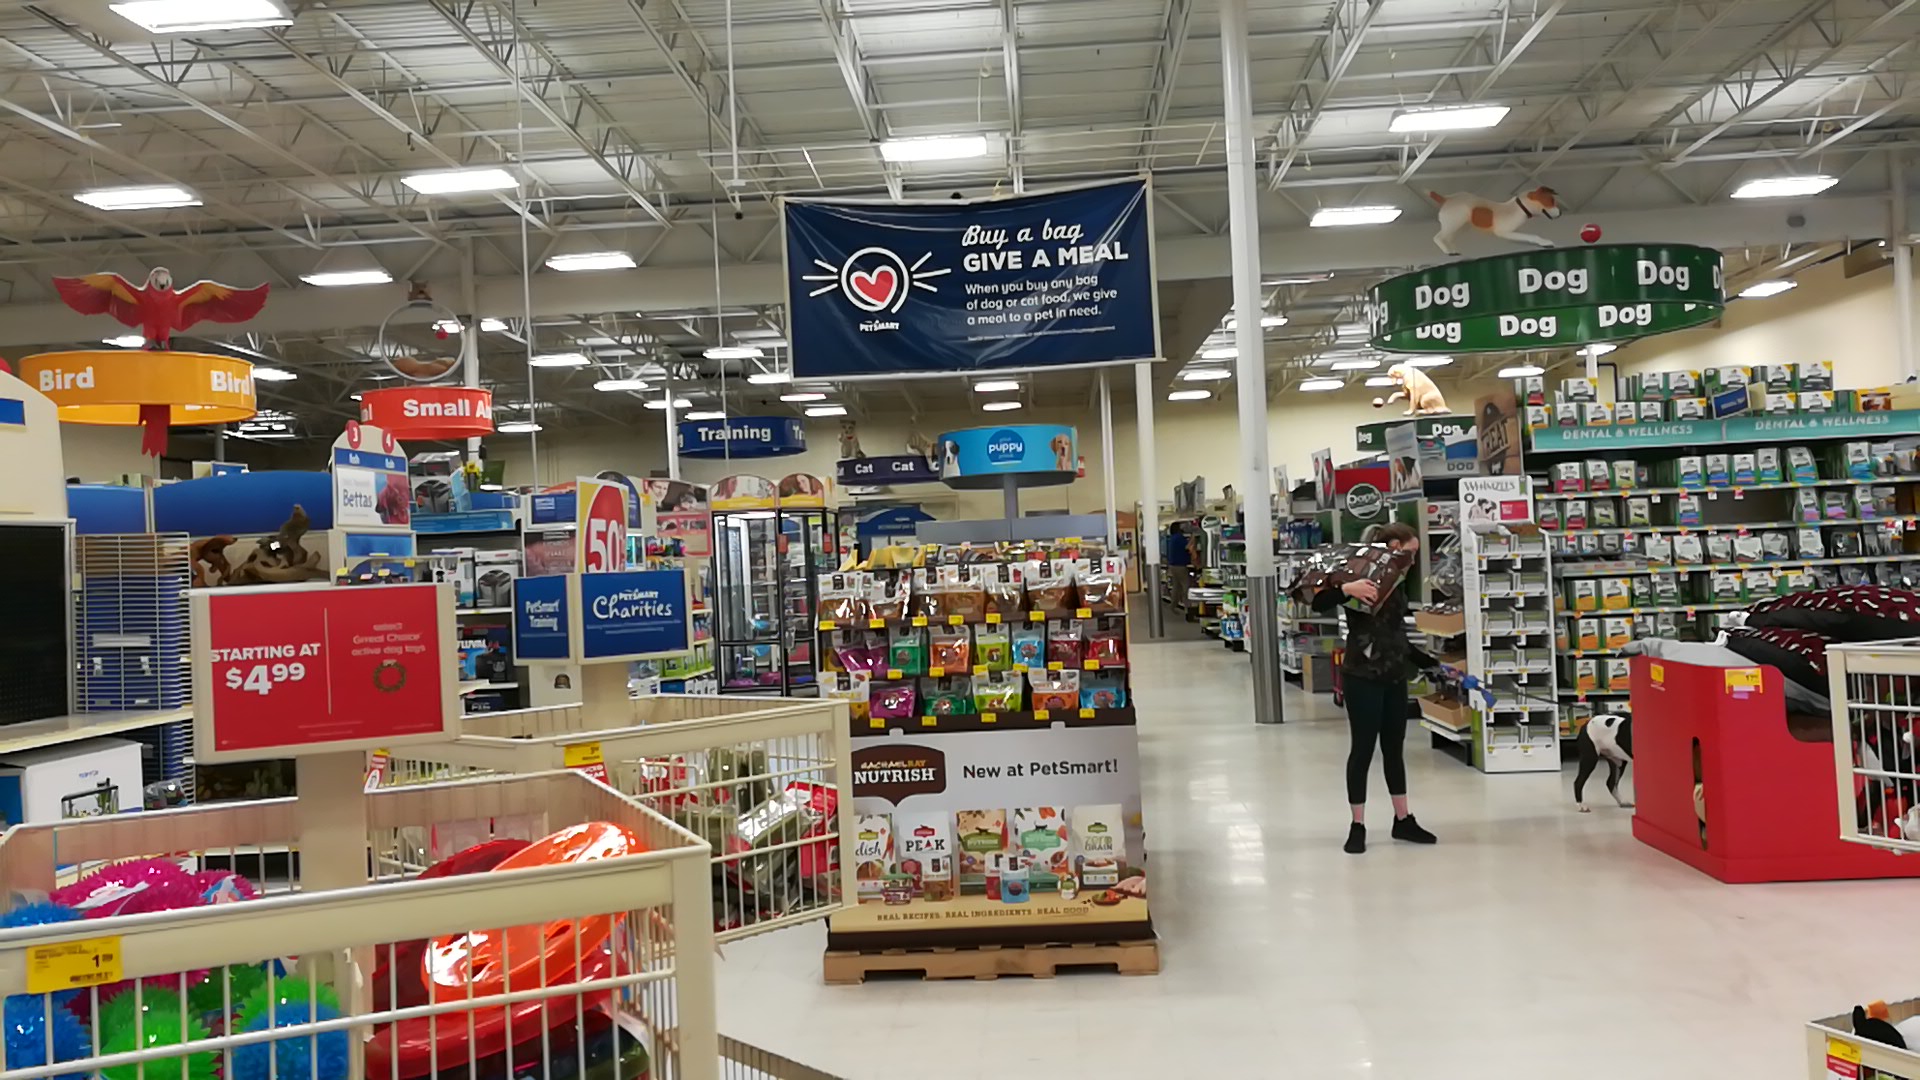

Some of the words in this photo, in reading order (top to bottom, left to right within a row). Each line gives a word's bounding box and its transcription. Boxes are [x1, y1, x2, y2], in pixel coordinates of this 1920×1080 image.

[961, 225, 1009, 250] Buy
[1017, 229, 1033, 243] a
[1042, 218, 1084, 245] bag
[963, 250, 1023, 273] GIVE
[1032, 249, 1051, 268] A
[1058, 241, 1129, 267] MEAL
[965, 283, 999, 295] When
[1001, 283, 1024, 295] you
[1026, 280, 1048, 292] buy
[1050, 278, 1073, 289] any
[1075, 275, 1099, 287] bag
[1518, 268, 1589, 295] Dog
[1637, 260, 1690, 290] Dog
[966, 299, 979, 311] of
[980, 298, 1003, 311] dog
[1005, 298, 1018, 308] or
[1020, 296, 1039, 307] cat
[1072, 291, 1091, 301] we
[1092, 288, 1118, 302] give
[1415, 282, 1471, 310] Dog
[967, 316, 975, 326] a
[977, 313, 1007, 325] meal
[1009, 313, 1021, 322] to
[1023, 312, 1032, 321] a
[1034, 309, 1054, 323] pet
[1056, 308, 1067, 319] in
[1069, 304, 1102, 317] need.
[1598, 303, 1652, 328] Dog
[1415, 322, 1462, 343] Dog
[1499, 315, 1557, 338] Dog
[39, 365, 95, 392] Bird
[210, 368, 251, 396] Bird
[403, 398, 471, 418] Small
[1562, 426, 1612, 440] DENTAL
[1628, 425, 1693, 437] WELLNESS
[1756, 417, 1805, 431] DENTAL
[1822, 414, 1890, 428] WELLNESS
[697, 424, 772, 442] Training
[988, 442, 1023, 455] puppy
[855, 463, 874, 474] Cat
[891, 461, 915, 472] Cat
[343, 488, 373, 508] Bettas
[592, 593, 673, 620] Charities
[211, 645, 296, 663] STARTING
[299, 643, 321, 658] AT
[854, 767, 937, 785] NUTRISH
[963, 765, 1001, 779] New
[1007, 763, 1024, 778] at
[1030, 758, 1118, 776] PetSmart!
[855, 841, 882, 857] dish
[905, 838, 945, 853] PEAK
[945, 910, 969, 920] REAL
